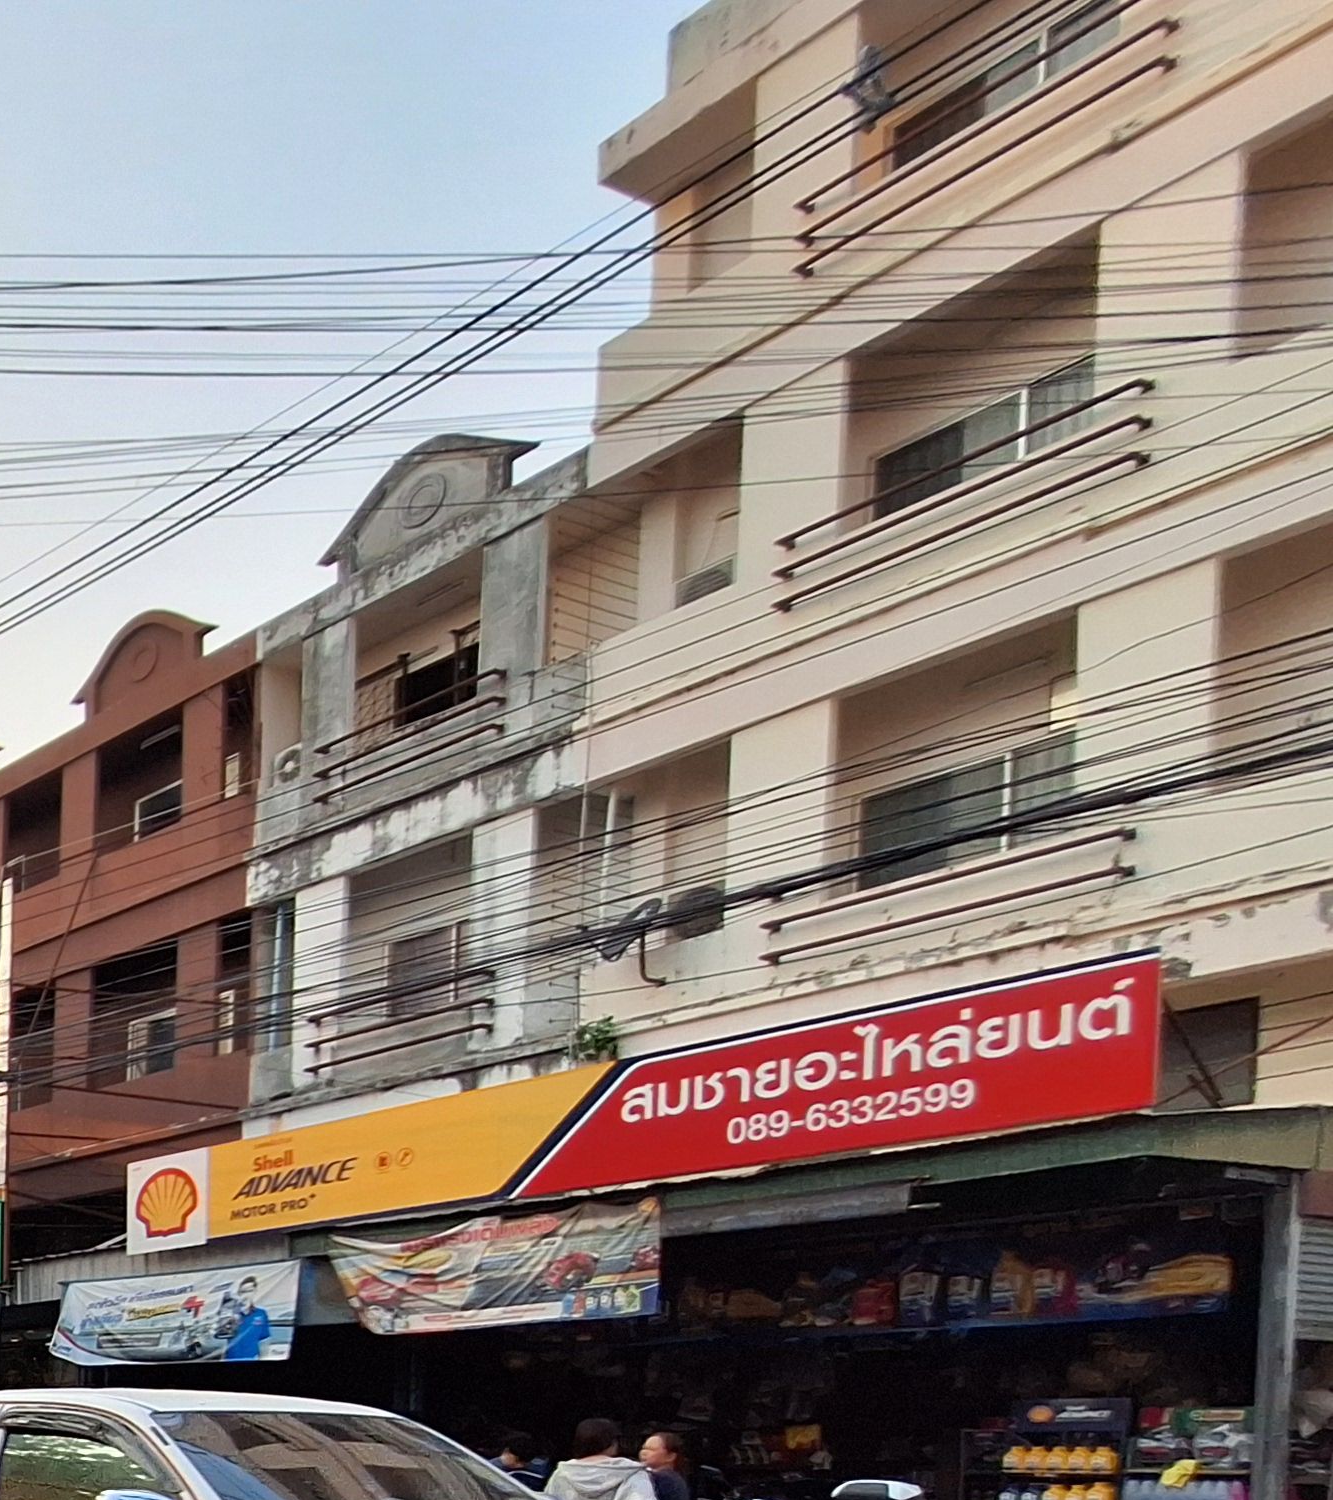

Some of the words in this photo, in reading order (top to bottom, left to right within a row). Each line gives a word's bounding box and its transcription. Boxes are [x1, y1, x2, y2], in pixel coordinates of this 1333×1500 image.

[619, 977, 1137, 1124] สมชายอะไหล่ยนต์
[725, 1078, 978, 1145] 089-6332599
[231, 1157, 359, 1201] ADVANCE
[251, 1150, 295, 1173] Shell
[229, 1204, 277, 1221] MOTOR
